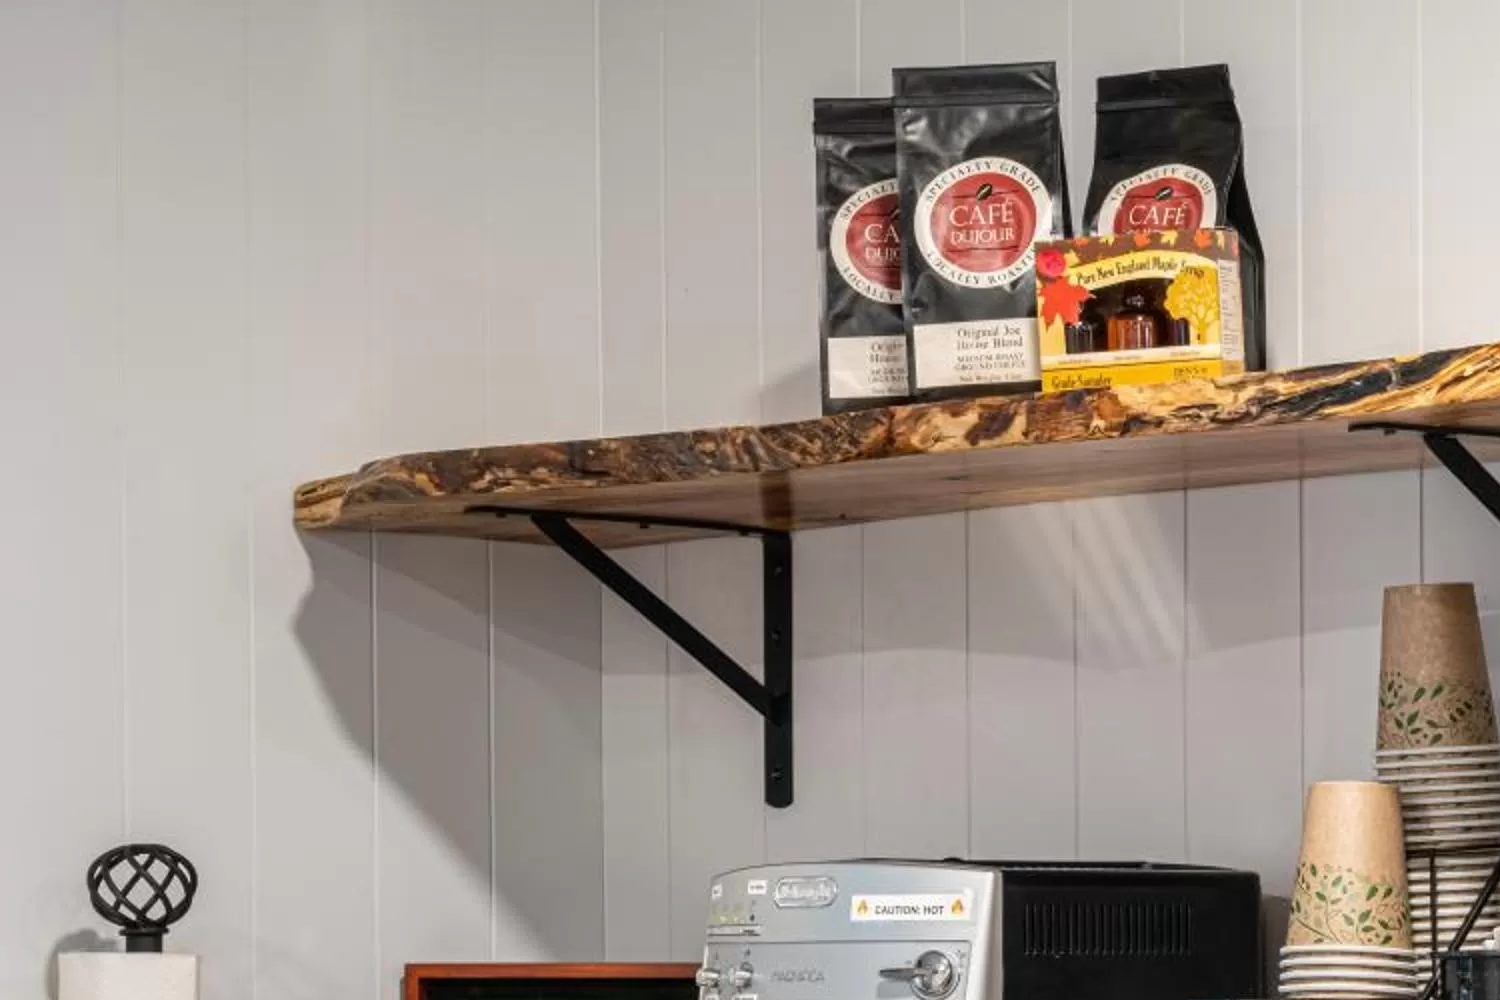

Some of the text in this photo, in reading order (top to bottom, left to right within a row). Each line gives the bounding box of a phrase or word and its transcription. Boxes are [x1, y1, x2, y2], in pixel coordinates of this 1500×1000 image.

[926, 160, 1041, 201] SPECIALTY GRADE
[949, 198, 1015, 228] CAFÉ
[1115, 258, 1150, 275] England
[923, 904, 945, 915] HOT
